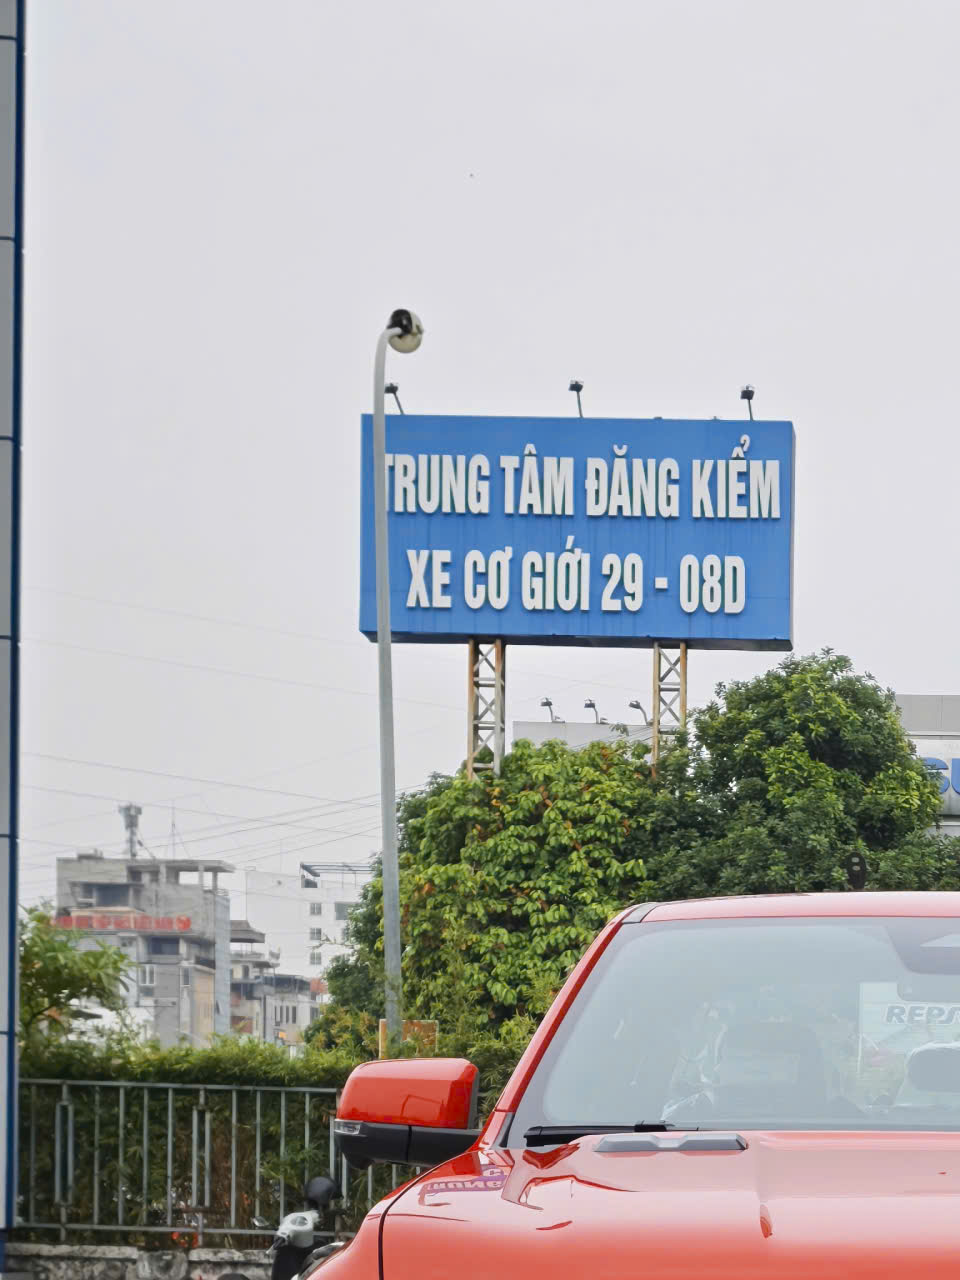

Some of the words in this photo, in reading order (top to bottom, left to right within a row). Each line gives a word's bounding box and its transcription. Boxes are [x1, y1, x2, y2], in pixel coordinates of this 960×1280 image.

[500, 443, 574, 516] TÂM
[585, 445, 680, 518] ĐĂNG
[692, 435, 781, 519] KIỂM
[406, 550, 452, 609] XE
[464, 546, 513, 610] CƠ
[522, 536, 590, 611] GIỚI
[601, 553, 643, 612] 29
[680, 555, 746, 614] 08D
